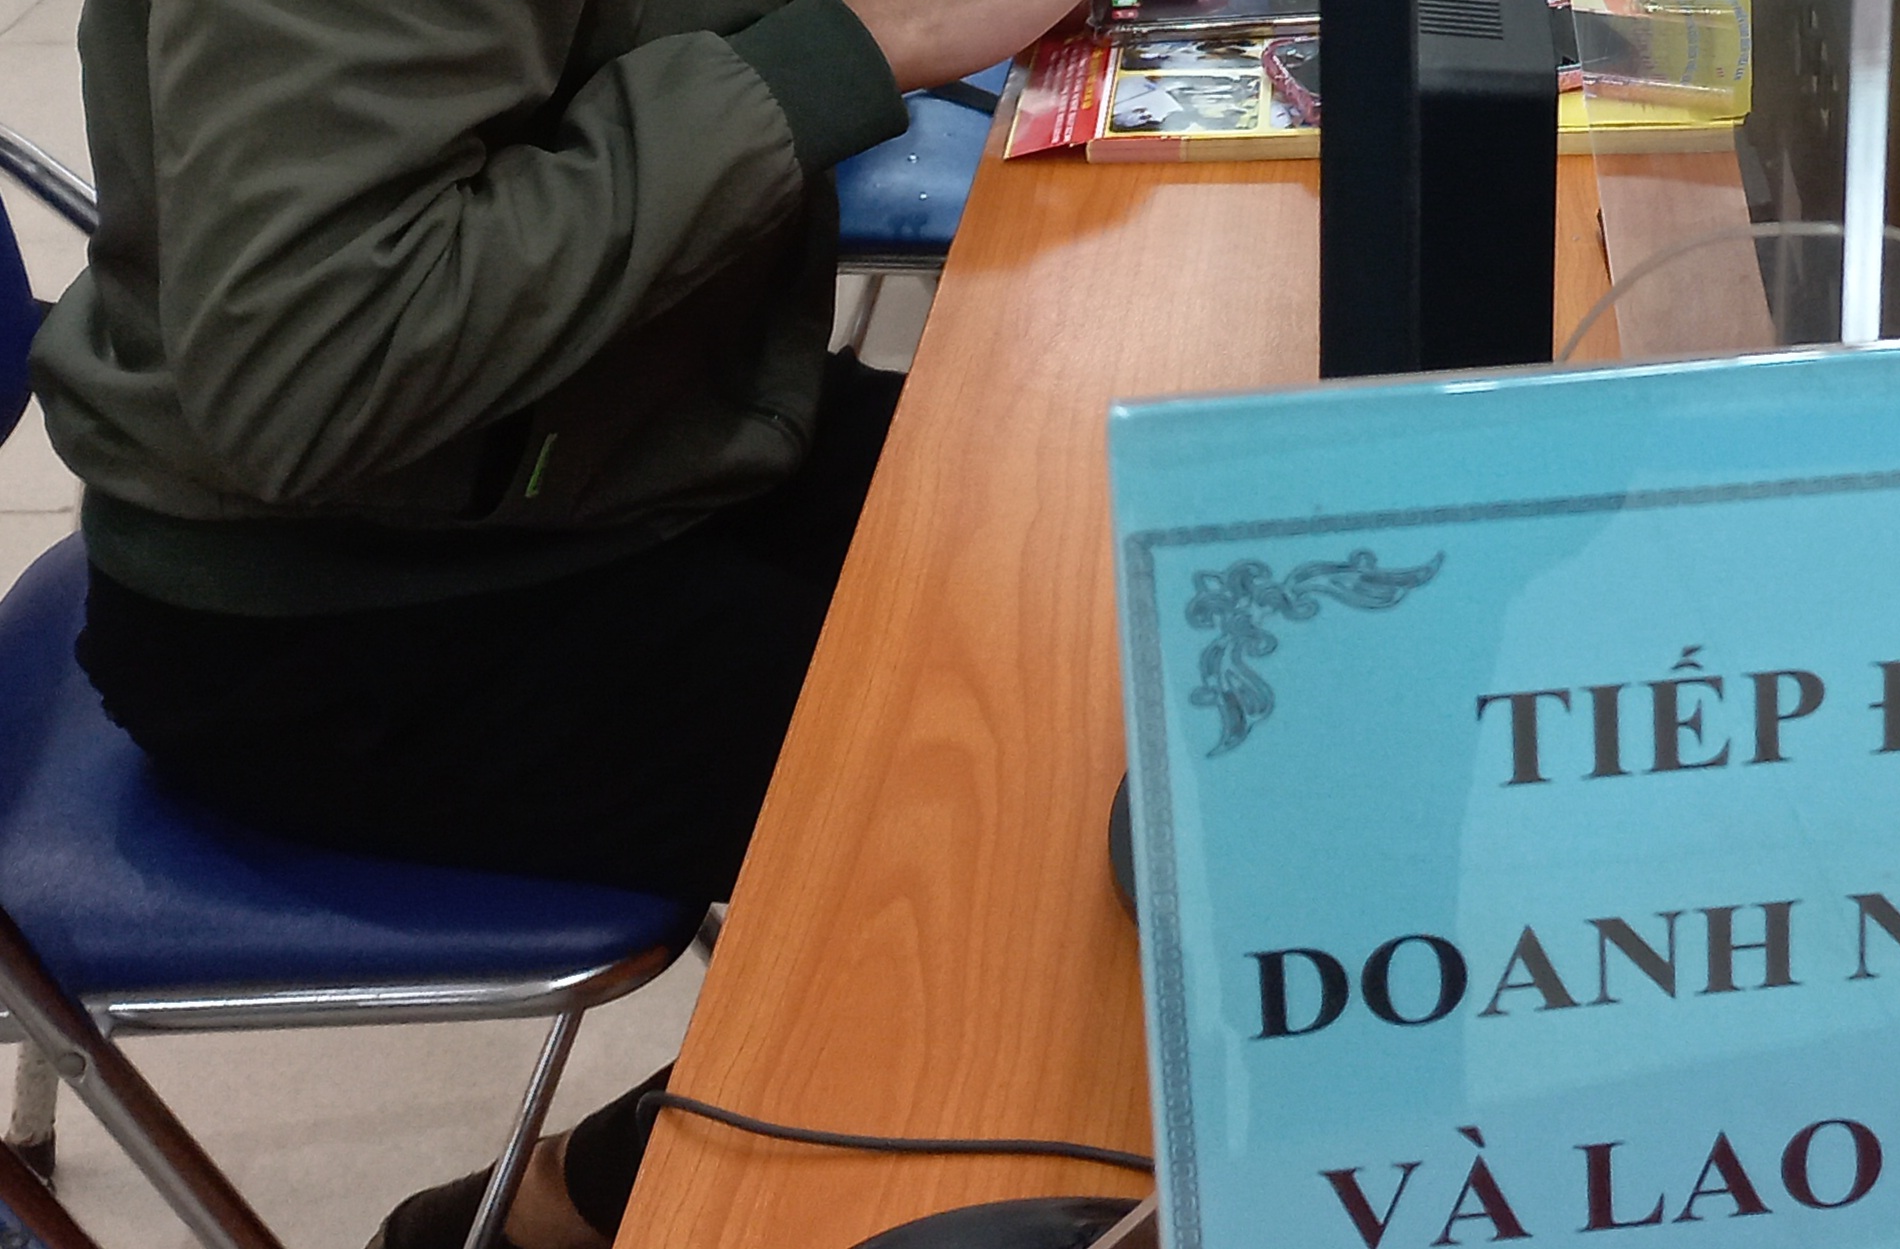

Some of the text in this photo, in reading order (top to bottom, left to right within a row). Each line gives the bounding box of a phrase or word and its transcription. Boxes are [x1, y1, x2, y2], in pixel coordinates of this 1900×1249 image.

[1477, 645, 1825, 785] TIẾP
[1250, 899, 1800, 1040] DOANH
[1319, 1126, 1533, 1249] VÀ
[1574, 1118, 1884, 1234] LAO
